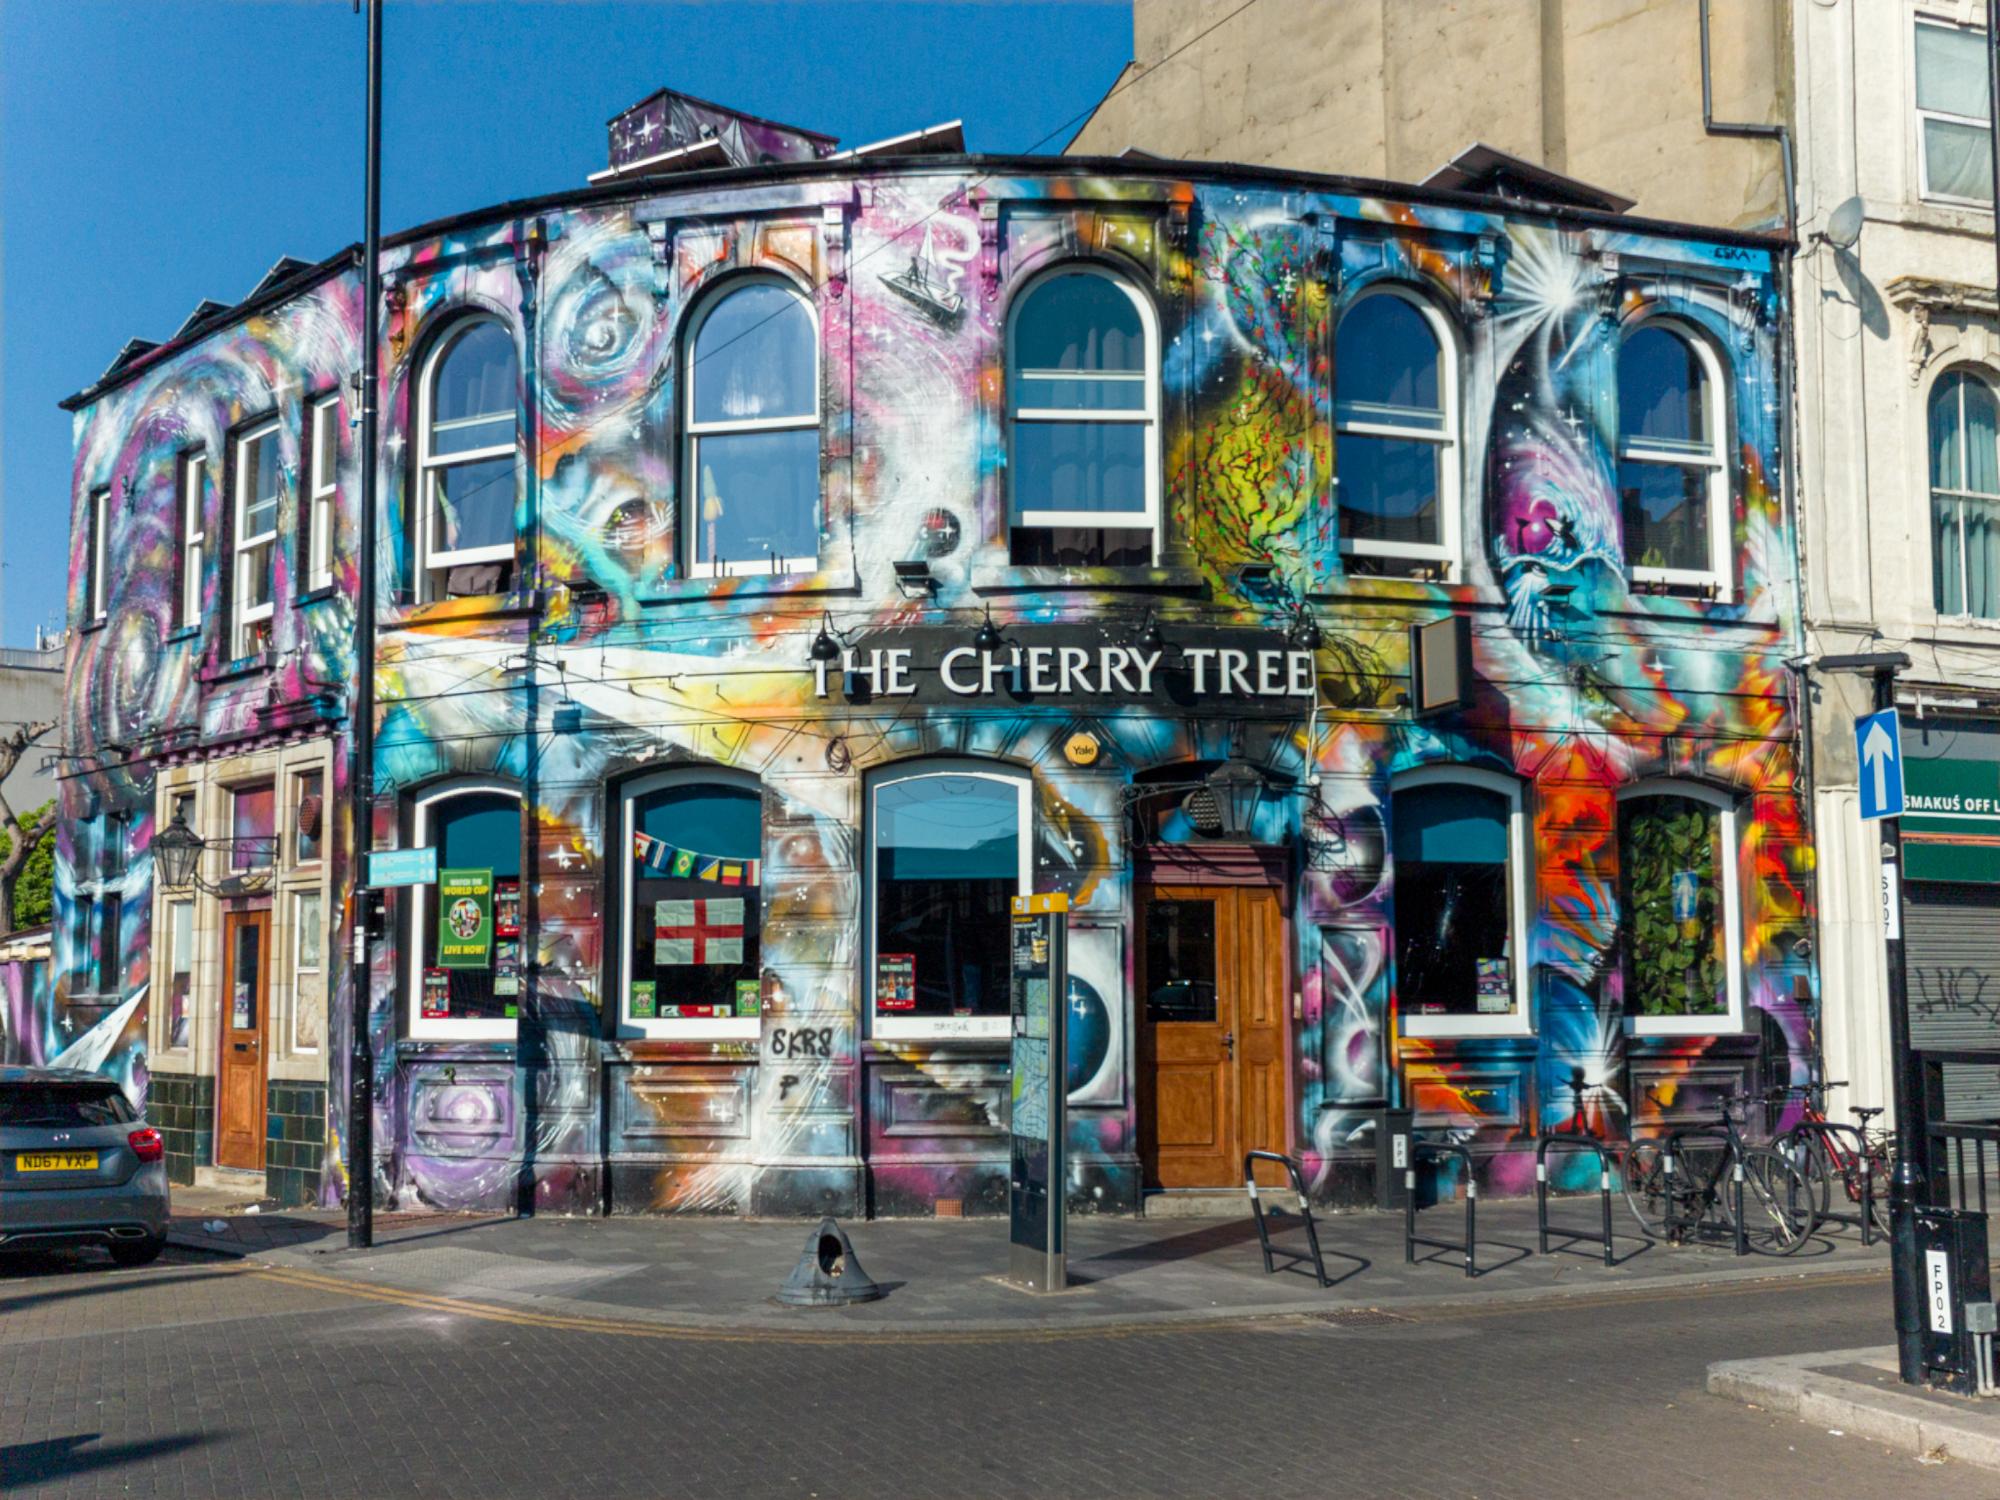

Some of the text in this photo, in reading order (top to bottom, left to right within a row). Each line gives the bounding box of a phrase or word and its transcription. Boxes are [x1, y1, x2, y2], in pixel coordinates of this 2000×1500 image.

[808, 646, 1317, 697] THE CHERRY TREE
[1073, 745, 1094, 755] Yale
[1964, 798, 1991, 813] OFF
[443, 885, 489, 896] WORLD CUP
[443, 945, 462, 955] LIVE
[23, 1154, 93, 1169] ND67 VXP
